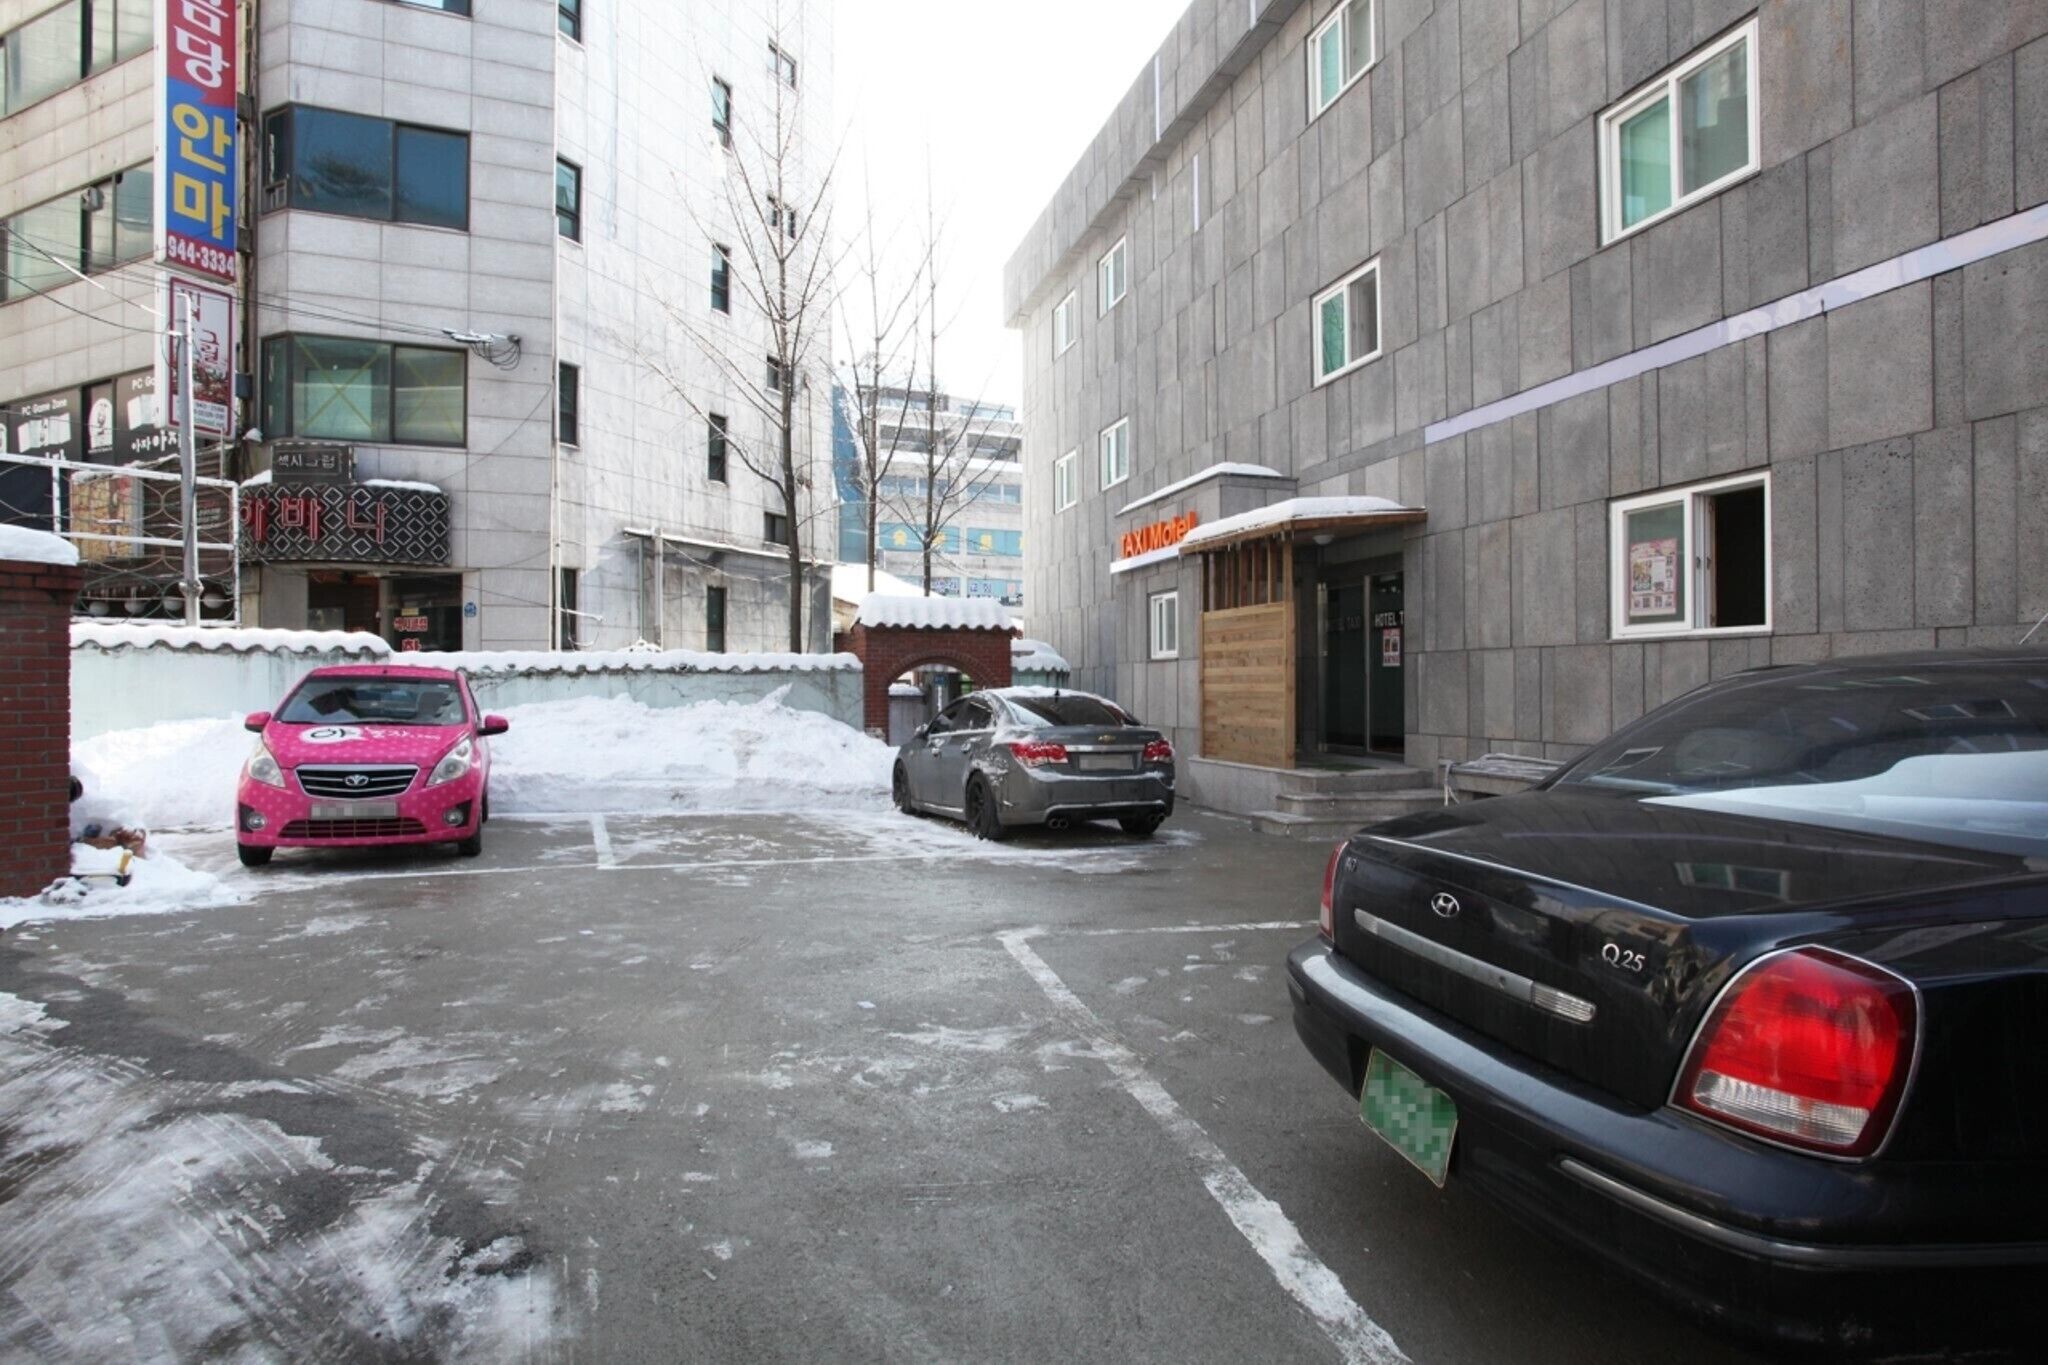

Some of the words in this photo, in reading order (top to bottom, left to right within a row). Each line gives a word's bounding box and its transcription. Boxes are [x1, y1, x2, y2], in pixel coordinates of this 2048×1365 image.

[172, 103, 232, 240] 안마
[168, 234, 236, 277] 944-3334
[132, 378, 143, 391] PC
[22, 405, 31, 416] PC
[1602, 943, 1646, 972] Q25
